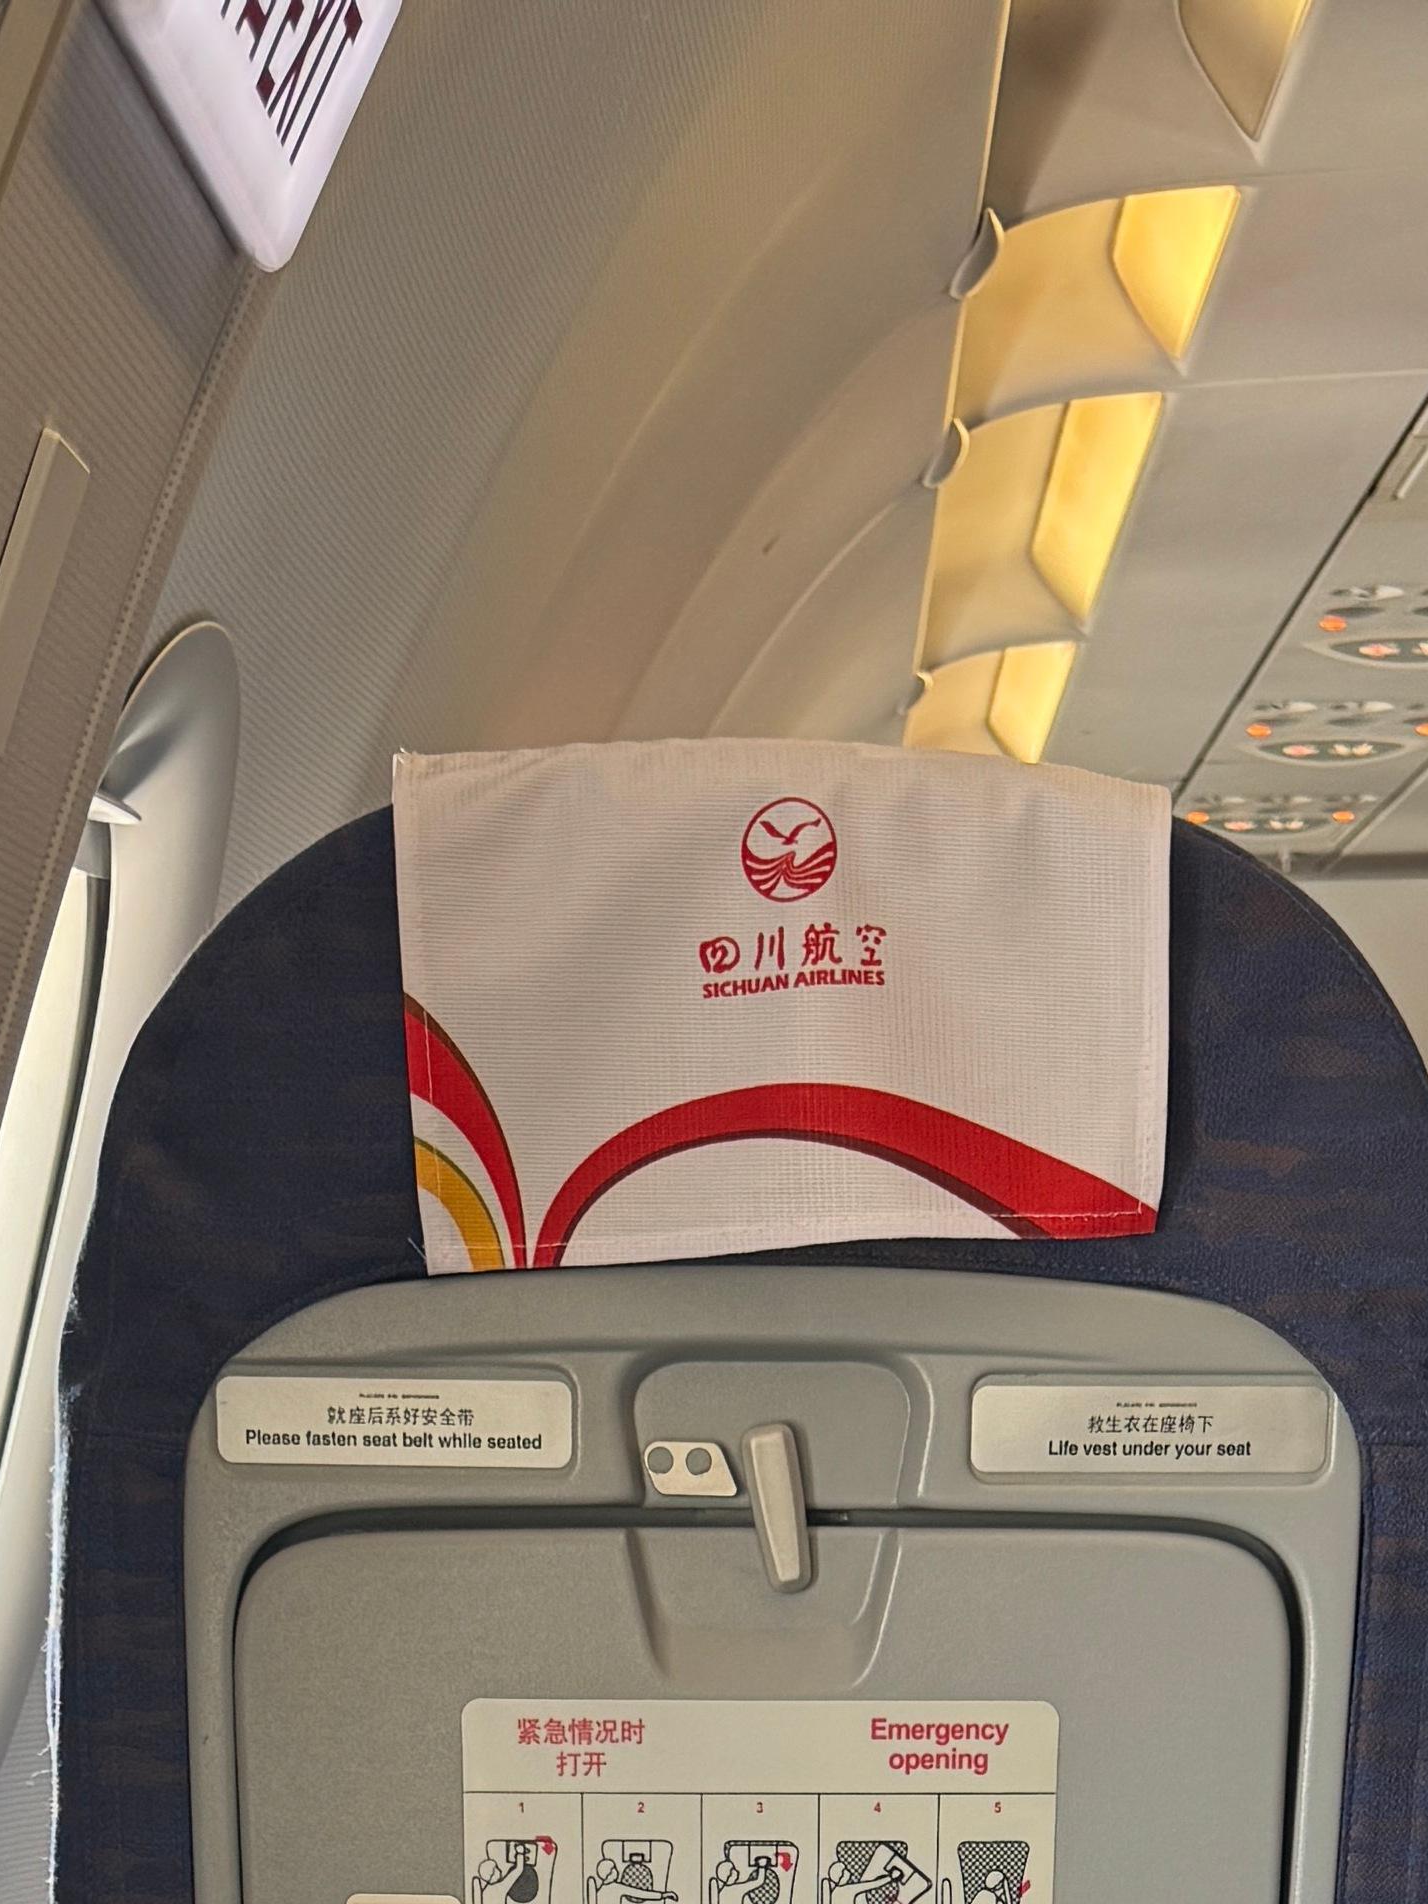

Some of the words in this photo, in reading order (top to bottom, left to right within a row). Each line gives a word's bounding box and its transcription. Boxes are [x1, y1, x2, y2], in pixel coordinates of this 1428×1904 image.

[699, 922, 887, 974] 四川航空
[702, 973, 789, 999] SICHUAN
[793, 968, 886, 988] AIRLINES
[327, 1405, 475, 1427] 就座后系好安全带
[1087, 1414, 1214, 1434] 救生衣在座椅下
[245, 1429, 300, 1446] Please
[306, 1430, 357, 1447] fasten
[362, 1432, 397, 1448] seat
[402, 1431, 434, 1449] belt
[438, 1431, 482, 1449] while
[487, 1433, 542, 1450] seated
[1048, 1440, 1079, 1456] Life
[1083, 1441, 1117, 1456] vest
[1122, 1441, 1169, 1457] under
[1174, 1443, 1212, 1460] your
[1217, 1441, 1252, 1457] seat
[517, 1718, 646, 1745] 紧急情况时
[871, 1718, 1010, 1746] Emergency
[556, 1751, 608, 1777] 打开
[889, 1748, 989, 1776] opening
[519, 1803, 525, 1813] 1
[637, 1802, 645, 1813] 2
[756, 1802, 764, 1813] 3
[874, 1802, 882, 1813] 4
[994, 1802, 1002, 1813] 5
